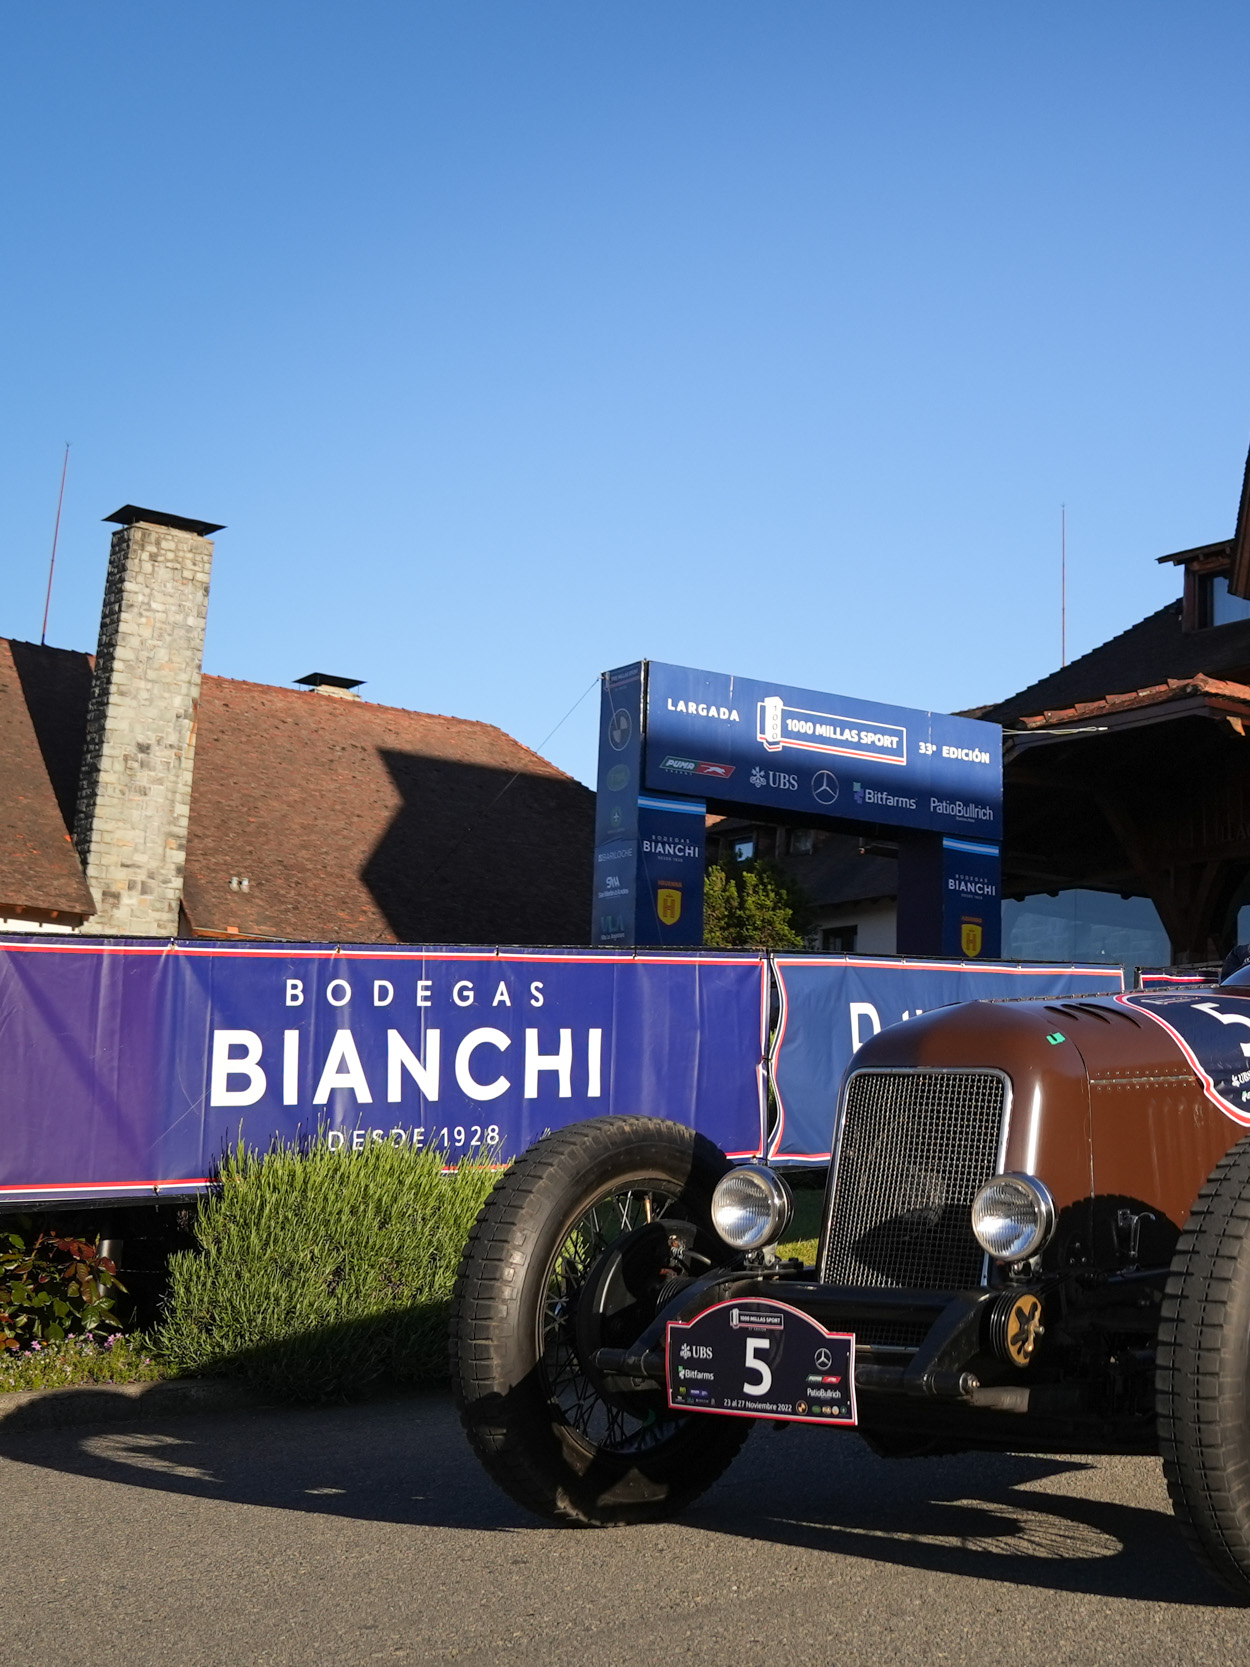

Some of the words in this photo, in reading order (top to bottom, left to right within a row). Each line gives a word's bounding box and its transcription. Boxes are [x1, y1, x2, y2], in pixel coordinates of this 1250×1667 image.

[668, 698, 739, 721] LARGADA
[786, 719, 813, 734] 1000
[815, 723, 859, 742] MILLAS
[860, 731, 899, 749] SPORT
[665, 759, 695, 770] PUMA
[942, 747, 990, 764] EDICIÓN
[768, 770, 798, 791] UBS
[865, 789, 916, 810] Bitfarms
[930, 797, 993, 821] PatioBullrich
[652, 834, 690, 844] BODEGAS
[643, 840, 699, 858] BIANCHI
[948, 878, 996, 896] BIANCHI
[284, 978, 545, 1007] BODEGAS
[210, 1026, 602, 1107] BIANCHI
[440, 1124, 500, 1147] 1928
[692, 1345, 713, 1360] UBS
[685, 1369, 715, 1381] Bitfarms
[743, 1337, 772, 1396] 5
[807, 1387, 841, 1398] PatioBullrich
[724, 1398, 731, 1407] 23
[738, 1399, 745, 1408] 27
[746, 1400, 777, 1411] Noviembre
[778, 1403, 792, 1412] 2022
